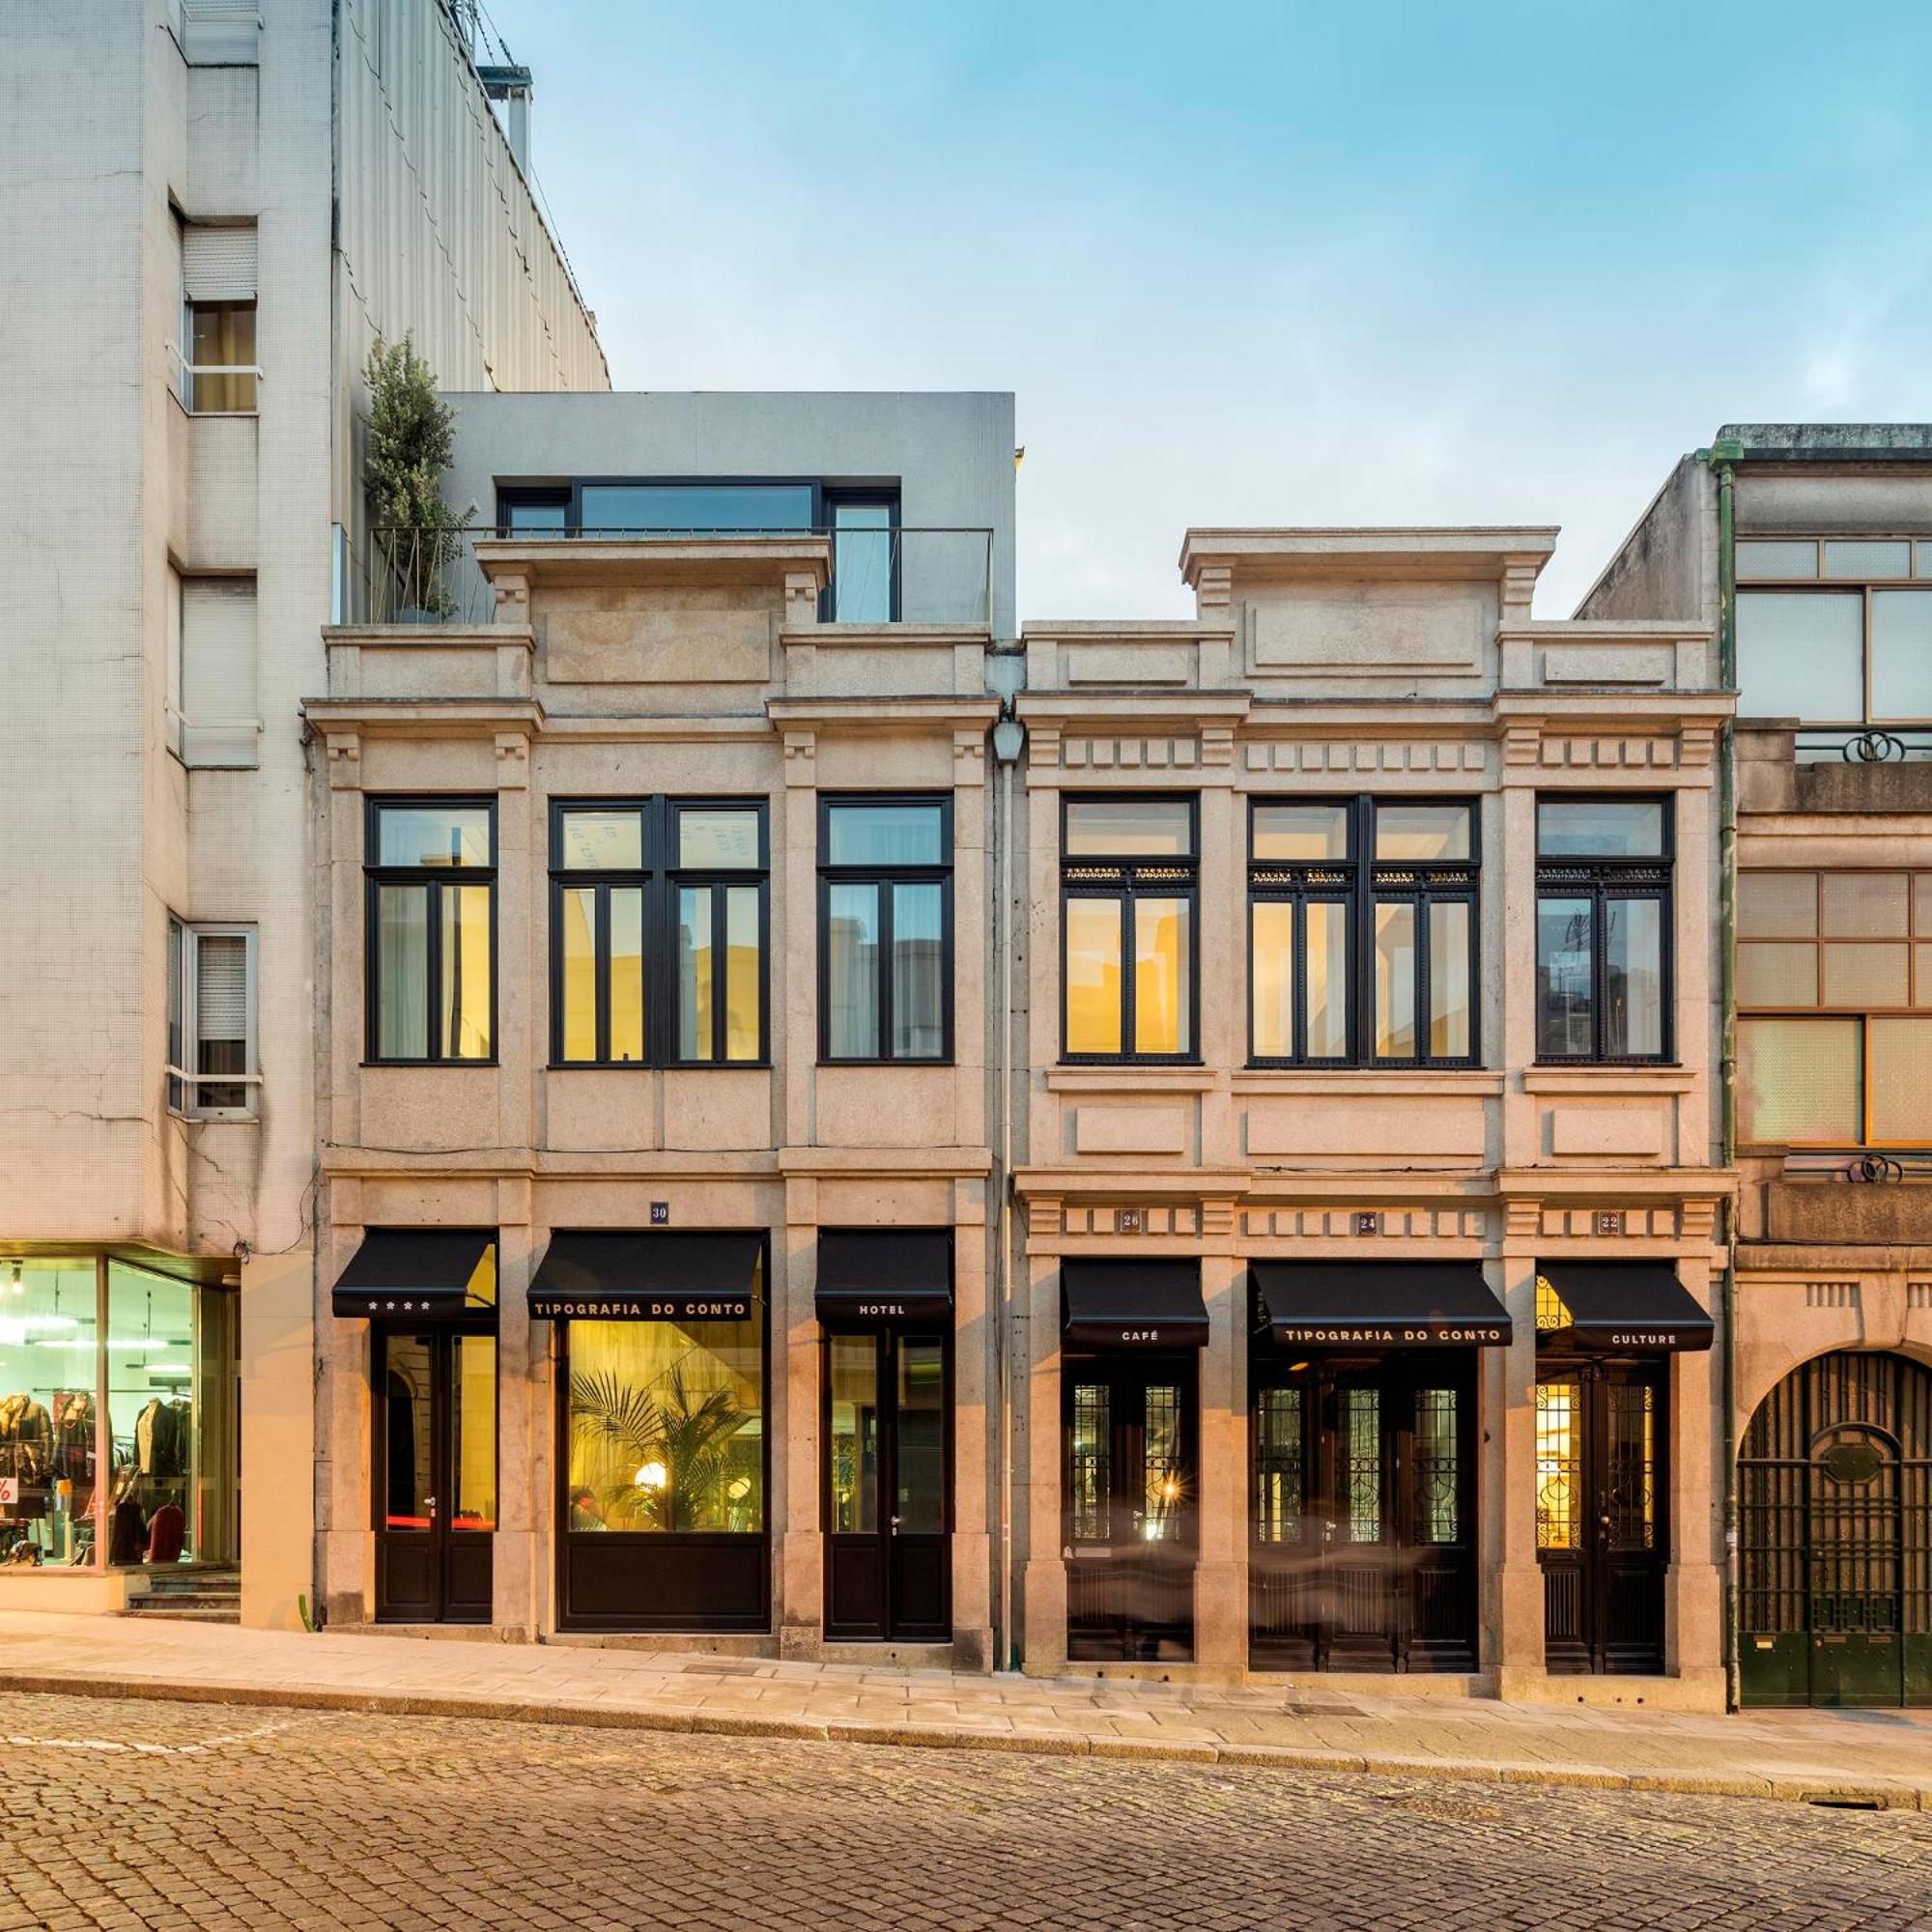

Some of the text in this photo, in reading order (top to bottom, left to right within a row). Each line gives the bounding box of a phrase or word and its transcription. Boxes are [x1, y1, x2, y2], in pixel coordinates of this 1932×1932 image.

[652, 1208, 666, 1219] 30
[1123, 1213, 1139, 1224] 26
[1360, 1215, 1376, 1228] 24
[1603, 1216, 1618, 1227] 22
[534, 1303, 745, 1315] TIPOGRAFIA DO CONTO
[859, 1305, 905, 1315] HOTEL
[1122, 1329, 1158, 1341] CAFÉ
[1285, 1329, 1500, 1341] TIPOGRAFIA DO CONTO
[1611, 1334, 1676, 1345] CULTURE
